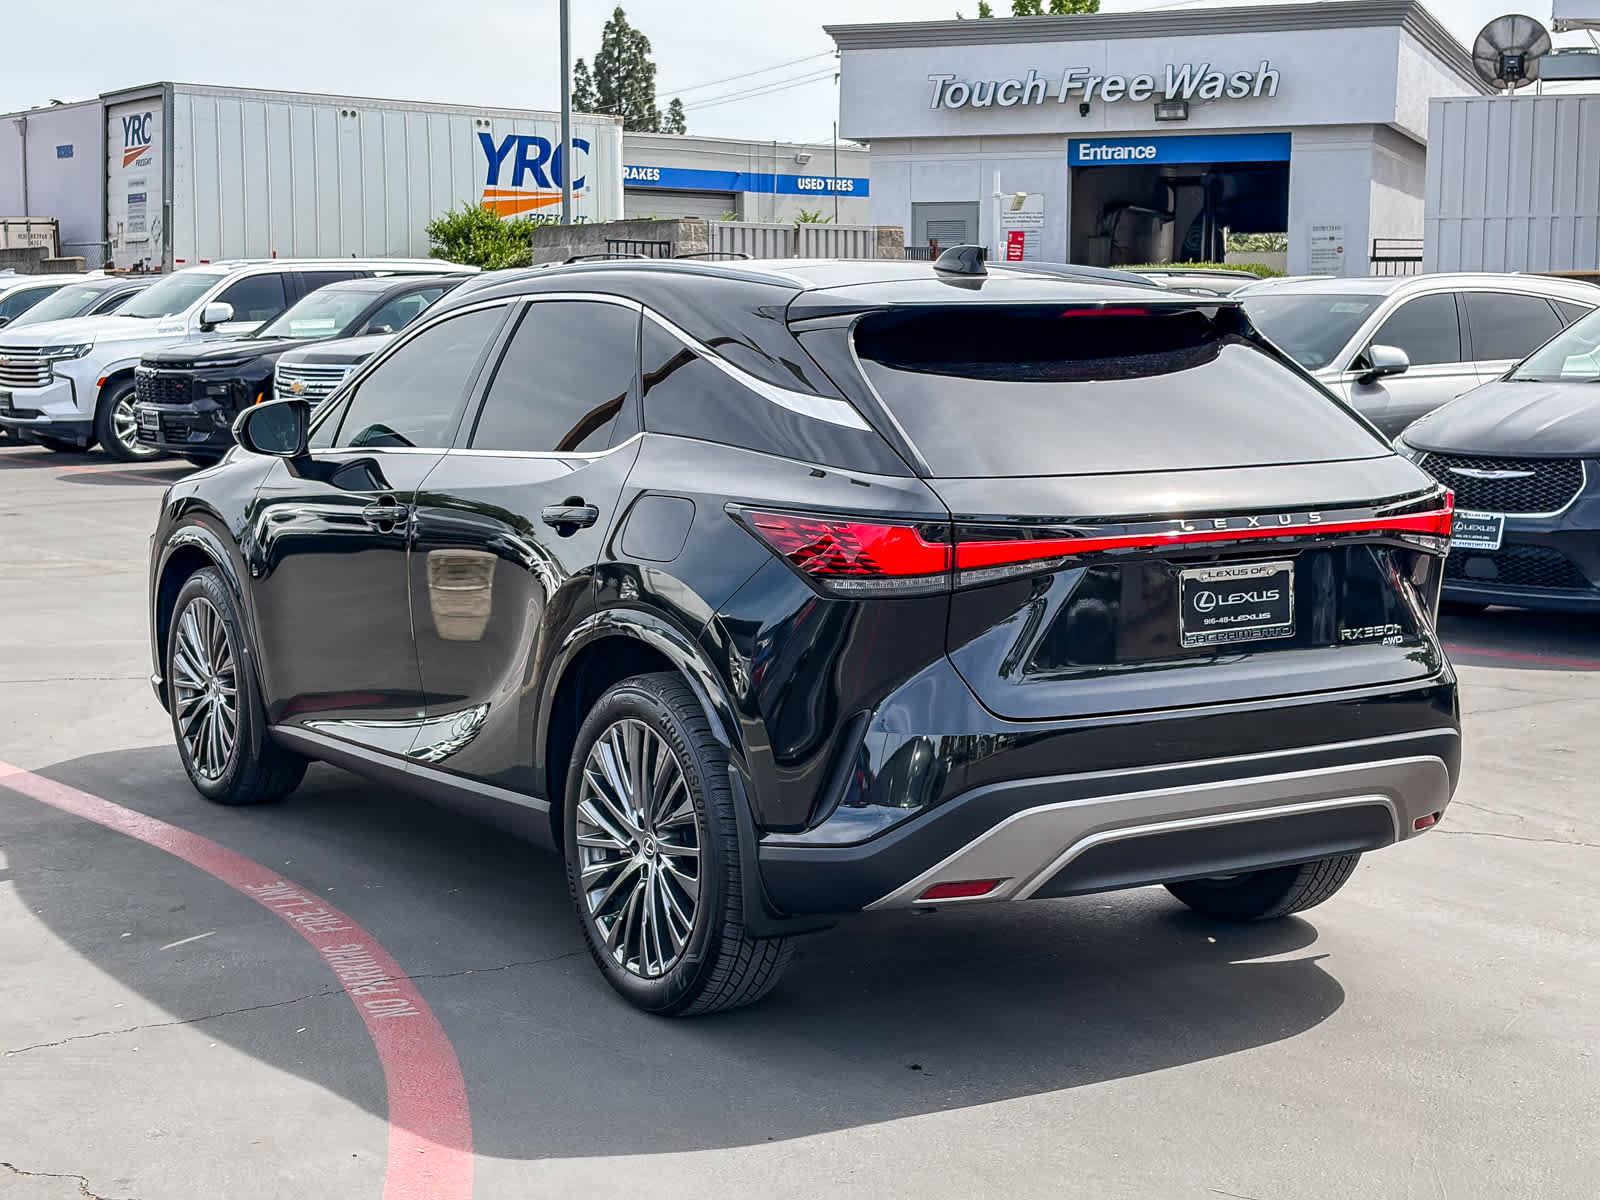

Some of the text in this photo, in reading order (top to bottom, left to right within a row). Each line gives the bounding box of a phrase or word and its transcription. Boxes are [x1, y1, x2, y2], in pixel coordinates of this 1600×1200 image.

[928, 60, 1280, 109] Touch Free Wash
[122, 111, 152, 147] YRC
[477, 131, 591, 191] YRC
[1079, 143, 1157, 160] Entrance
[797, 177, 854, 192] USED TIRES
[1180, 511, 1321, 531] LEXUS
[1208, 567, 1267, 578] LEXUS OF
[1218, 589, 1280, 605] LEXUS
[1382, 635, 1403, 646] AWD
[244, 880, 313, 909] LANE
[320, 943, 399, 996] PARKING
[363, 998, 420, 1018] NO
